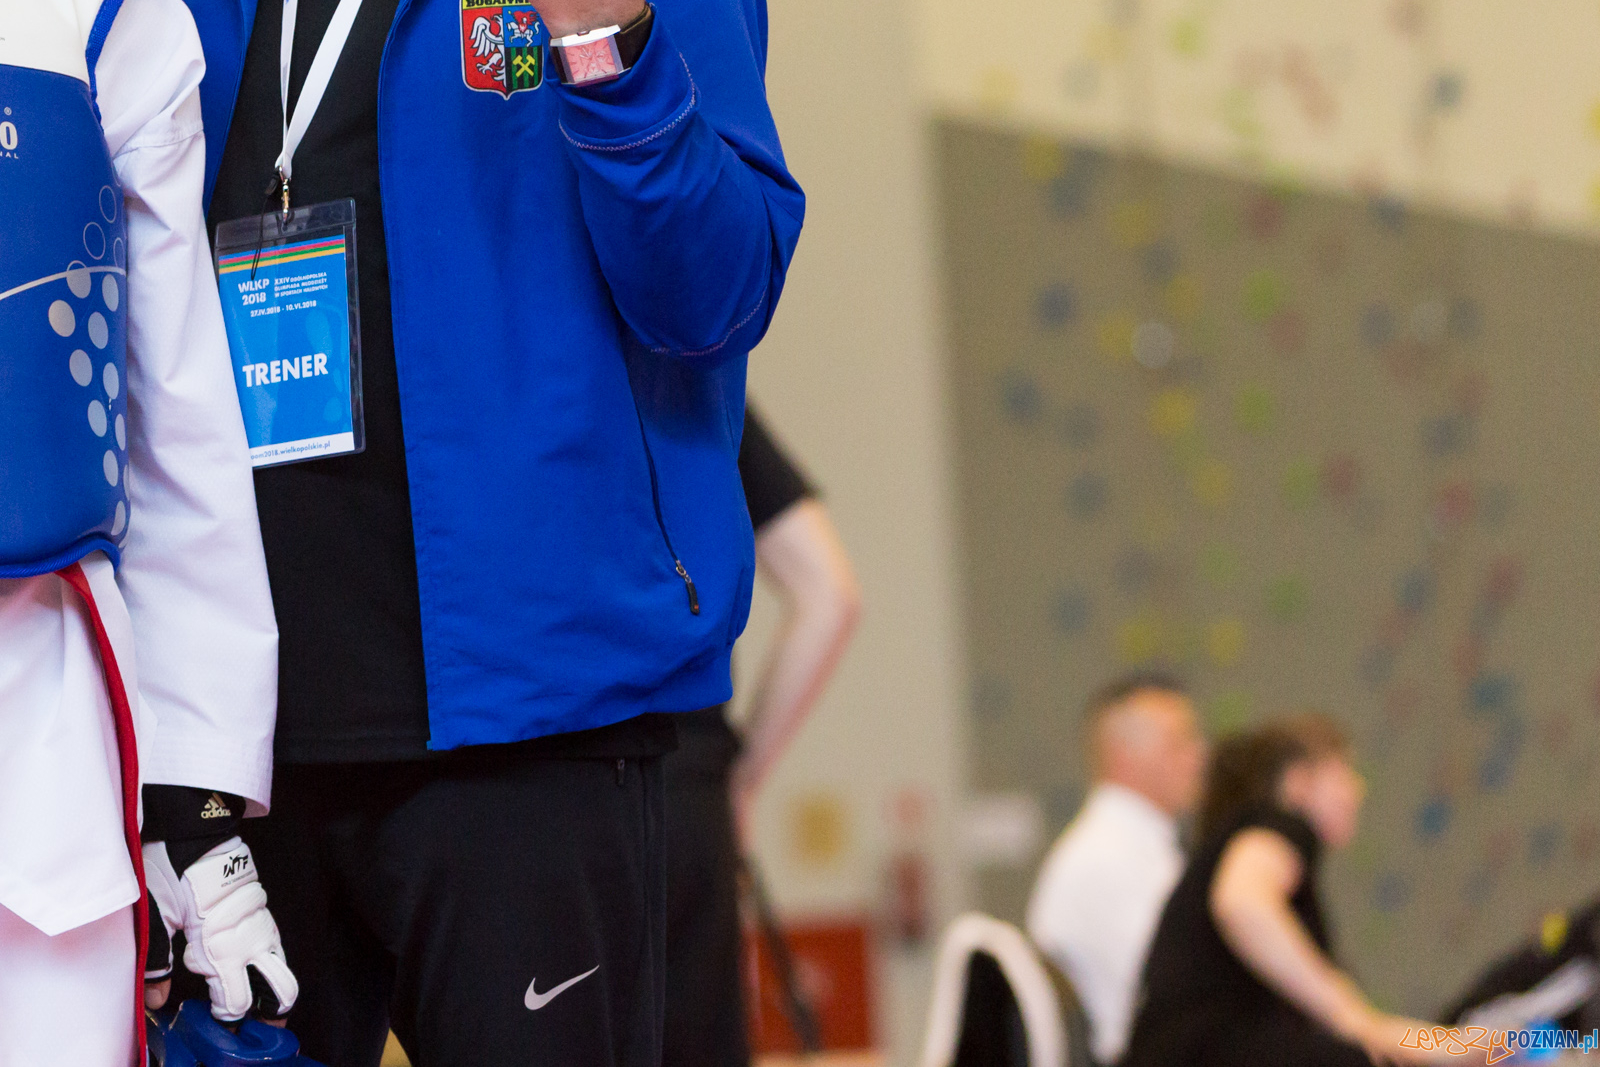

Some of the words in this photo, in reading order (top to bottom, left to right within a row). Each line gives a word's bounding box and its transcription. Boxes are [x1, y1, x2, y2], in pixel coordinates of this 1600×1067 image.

[238, 278, 270, 293] WLKP
[241, 292, 267, 306] 2018
[242, 352, 329, 388] TRENER
